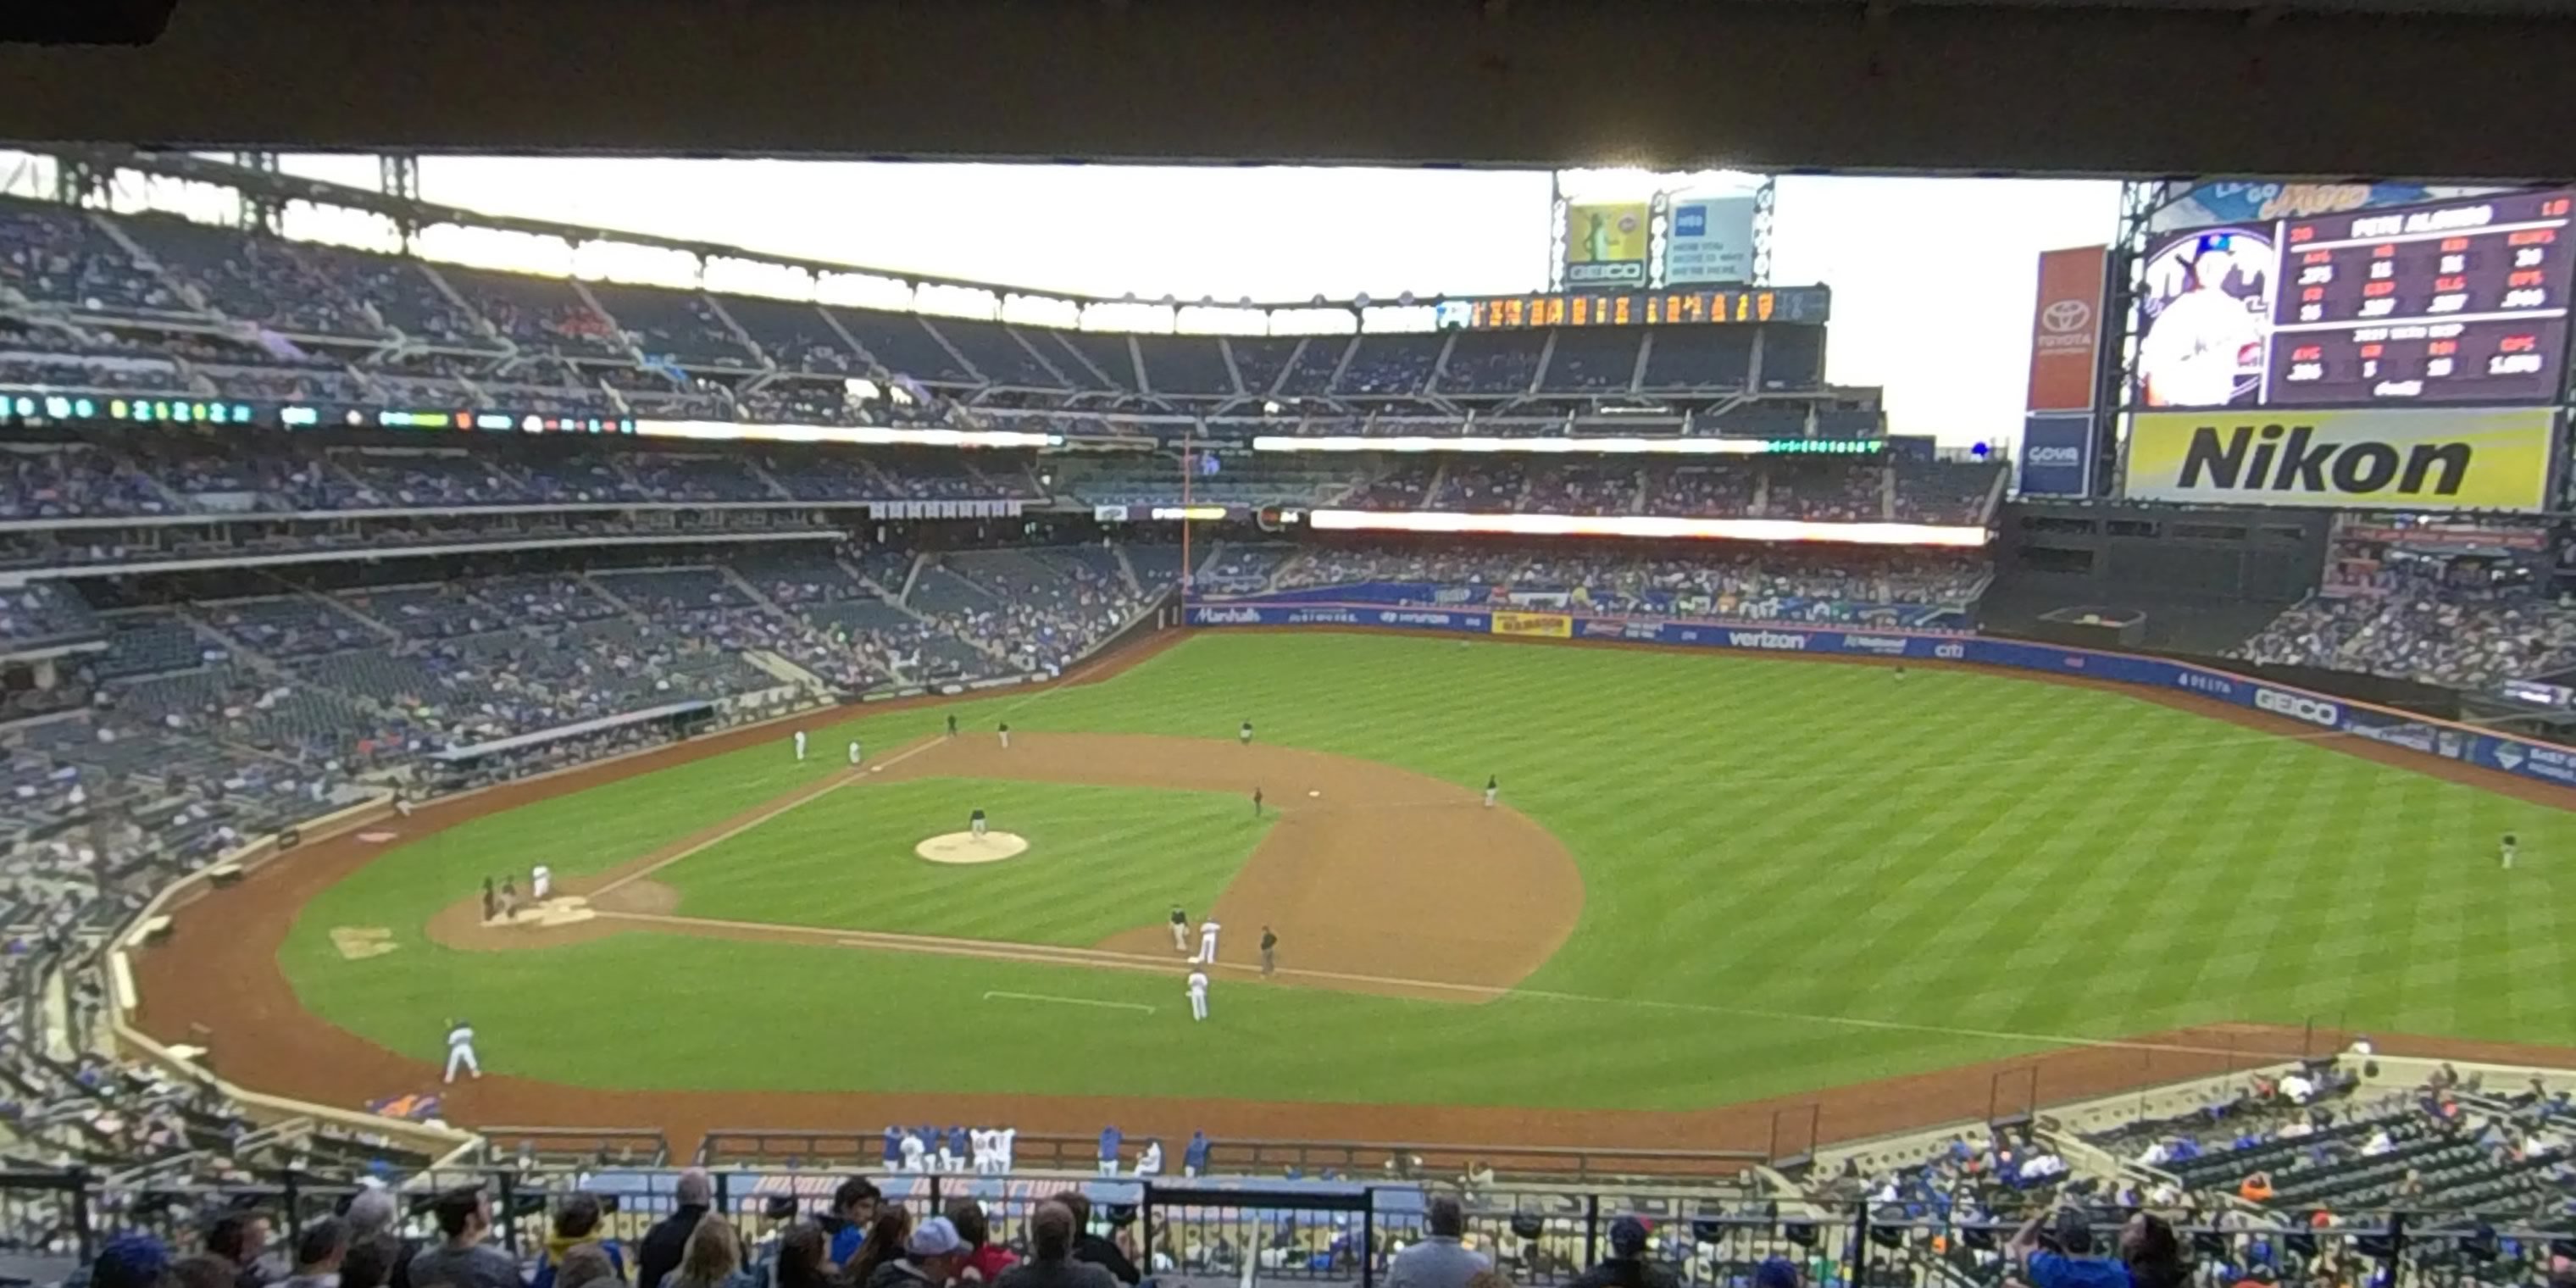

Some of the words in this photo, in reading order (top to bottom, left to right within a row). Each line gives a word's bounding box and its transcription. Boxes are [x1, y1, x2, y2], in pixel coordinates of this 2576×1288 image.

[1571, 264, 1641, 280] GEICO
[2038, 333, 2090, 347] TOYOTA
[2029, 447, 2079, 463] GOYA
[2178, 425, 2473, 497] Nikon
[1194, 608, 1261, 624] Marshalls
[1729, 631, 1805, 650] verizon
[1935, 643, 1964, 658] citi
[2254, 688, 2338, 726] GEICO
